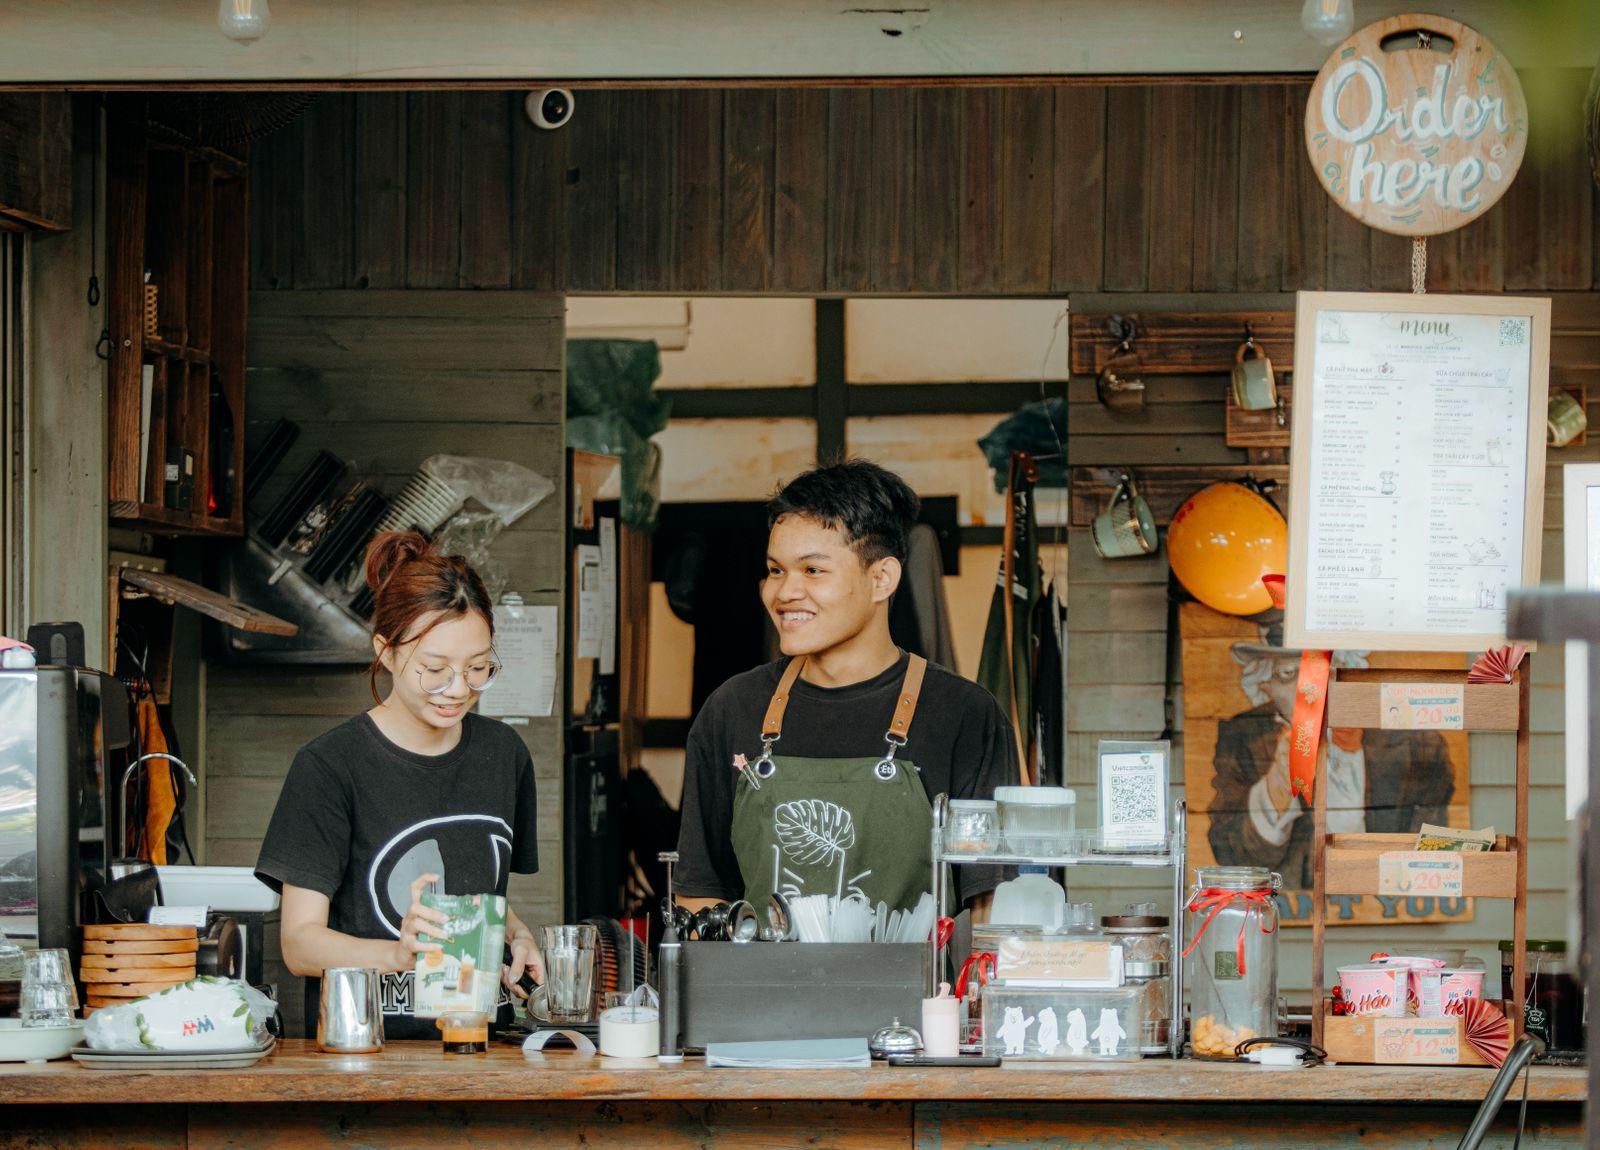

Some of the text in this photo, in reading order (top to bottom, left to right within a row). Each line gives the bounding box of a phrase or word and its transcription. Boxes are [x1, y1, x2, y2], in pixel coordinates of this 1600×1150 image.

[1321, 57, 1509, 144] Order
[1349, 144, 1485, 212] here
[1401, 320, 1453, 337] menu
[1416, 706, 1442, 725] 20
[1411, 871, 1441, 890] 20
[1375, 895, 1467, 918] YOU
[1359, 989, 1393, 1013] Hảo
[1414, 1039, 1440, 1057] 12
